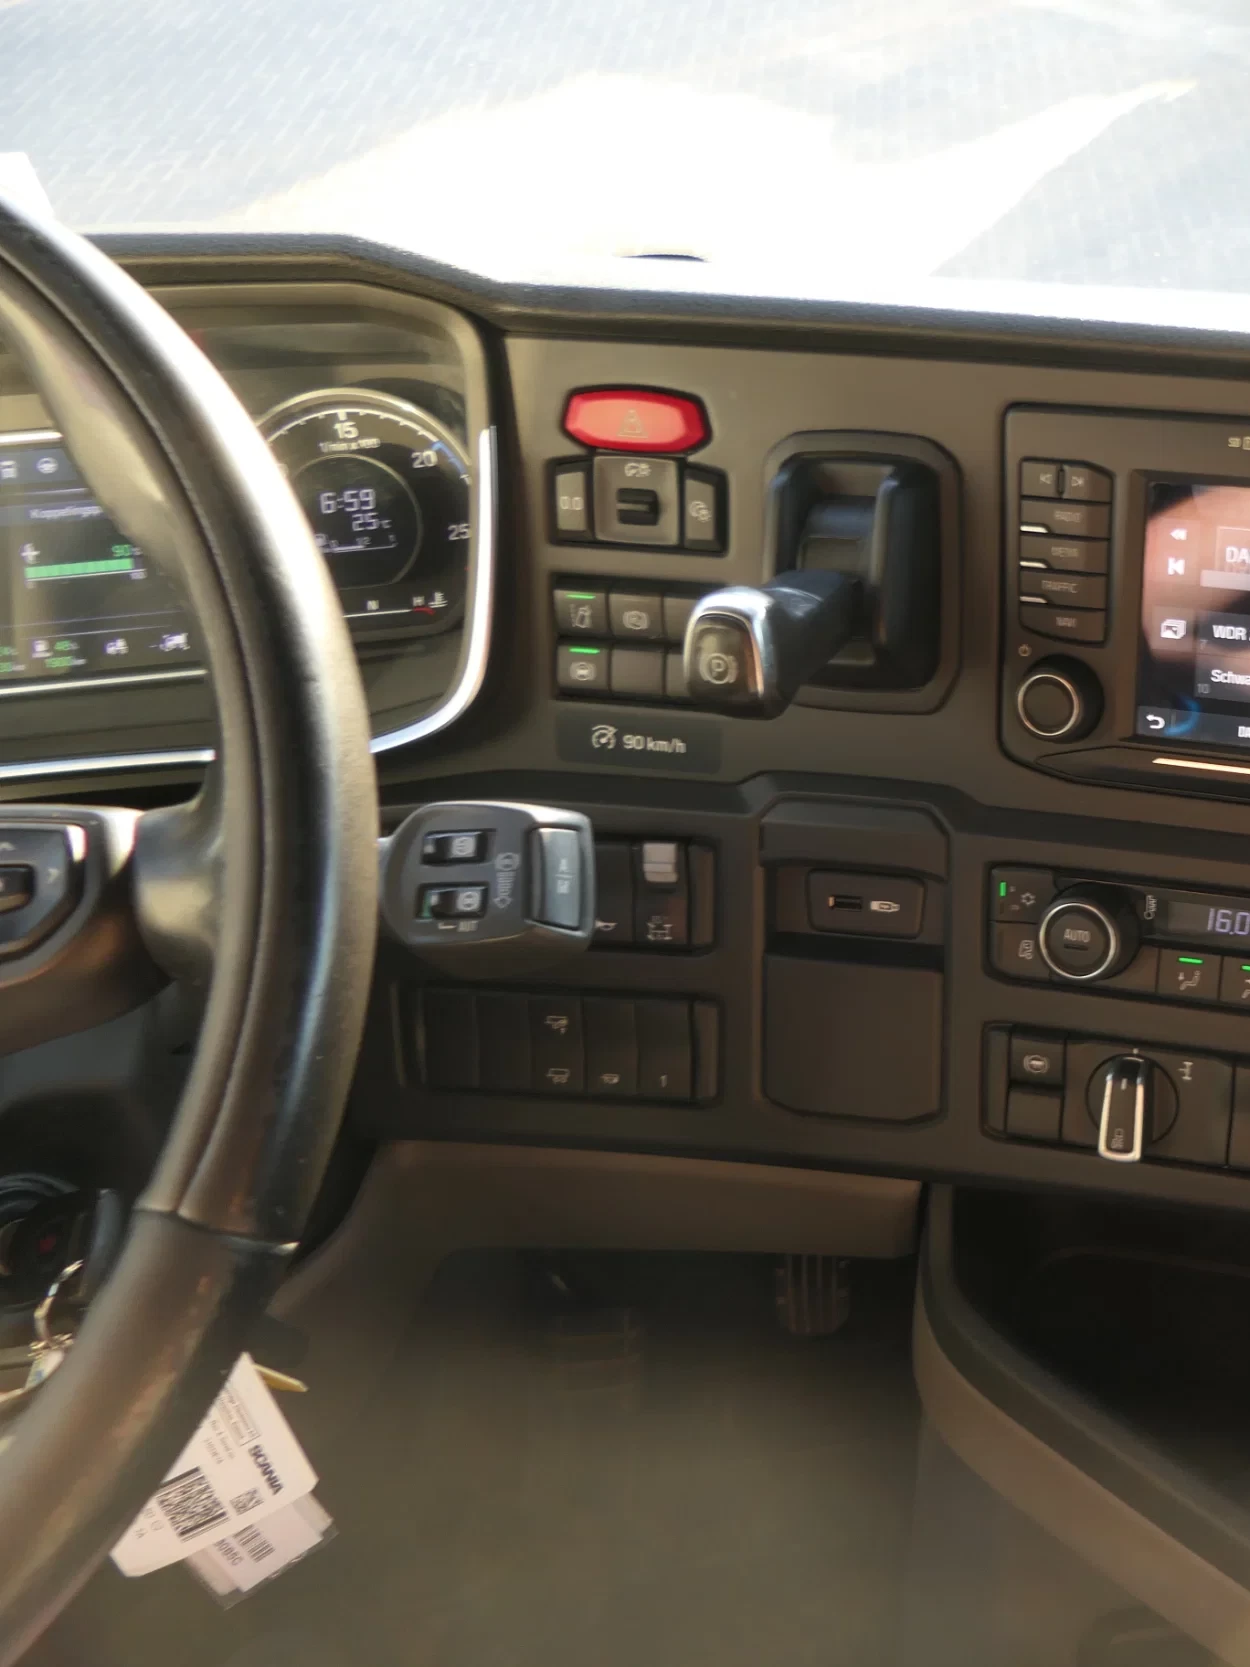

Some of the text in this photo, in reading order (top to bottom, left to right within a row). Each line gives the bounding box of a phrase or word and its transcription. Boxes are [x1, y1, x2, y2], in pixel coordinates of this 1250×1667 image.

[334, 422, 359, 439] 15
[411, 451, 438, 468] 20
[320, 488, 377, 514] 6:59
[352, 512, 379, 531] 25
[448, 523, 470, 541] 25
[1041, 579, 1078, 594] TRAFFIC
[1212, 625, 1247, 641] WDR
[623, 735, 687, 753] 90 km/h
[1206, 908, 1250, 936] 16.0
[1063, 928, 1091, 943] AUTO
[248, 1444, 284, 1496] SCANIA
